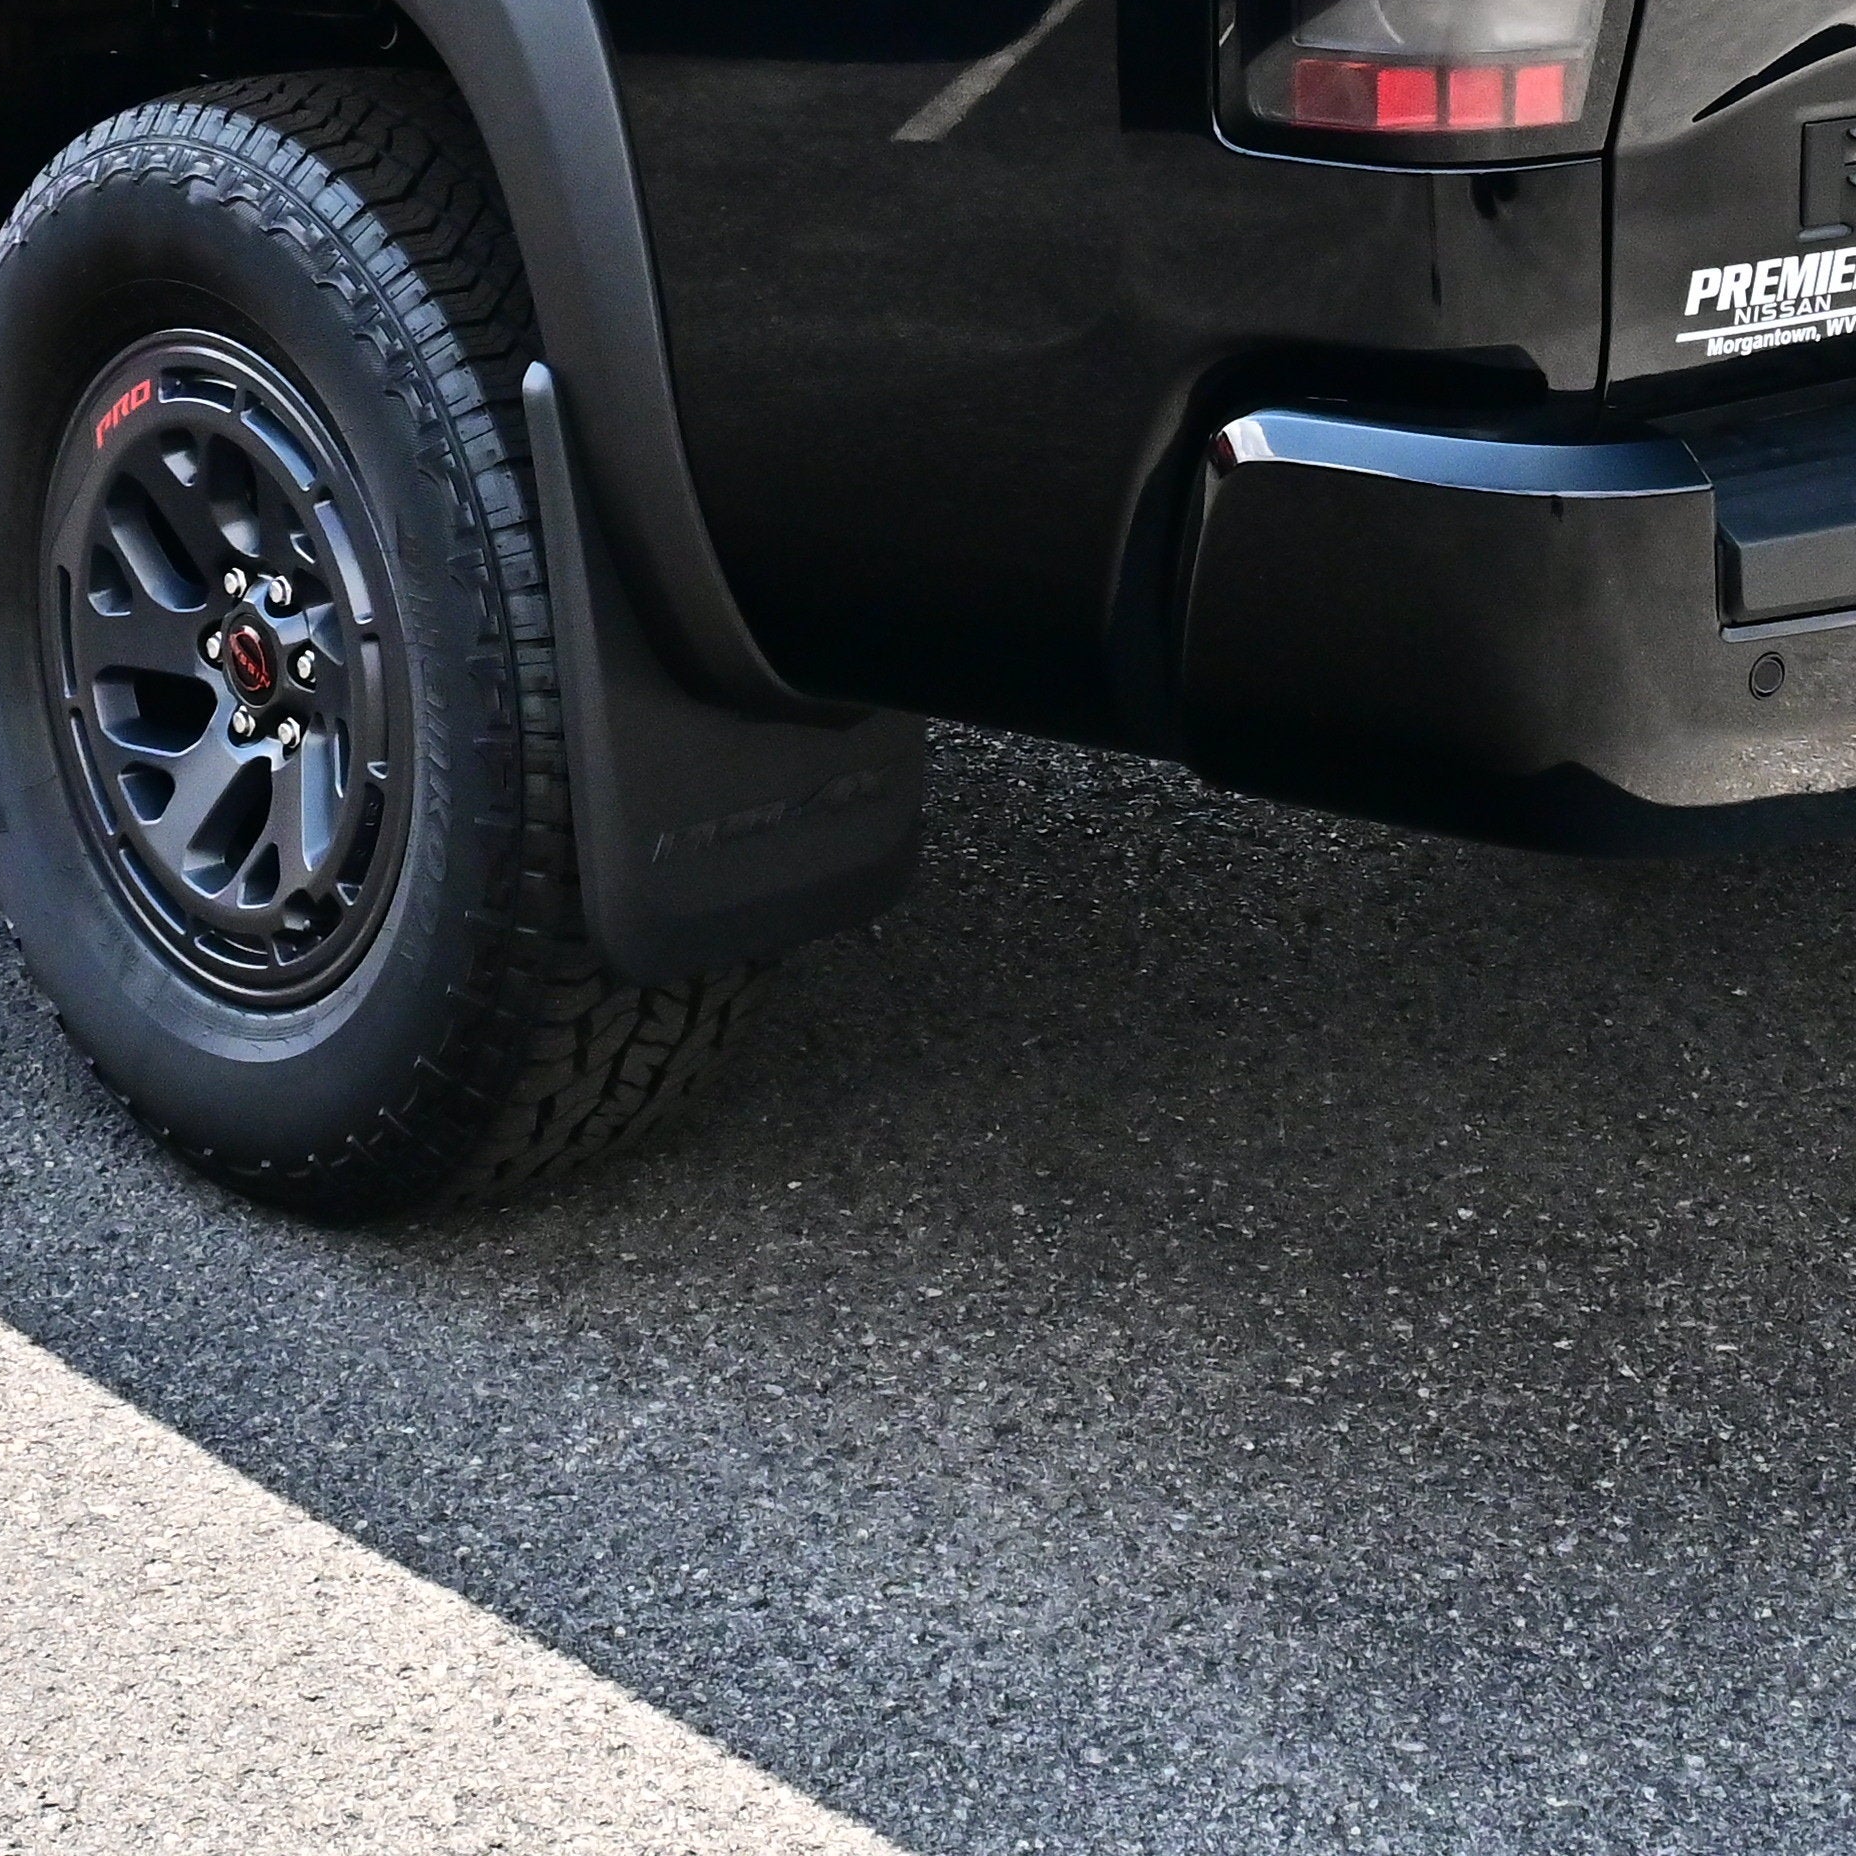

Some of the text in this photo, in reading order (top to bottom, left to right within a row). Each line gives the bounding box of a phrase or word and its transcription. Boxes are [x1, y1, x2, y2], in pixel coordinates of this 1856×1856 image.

[1733, 294, 1832, 326] NISSAN
[1706, 325, 1822, 357] Morgantown,
[95, 378, 152, 450] PRO
